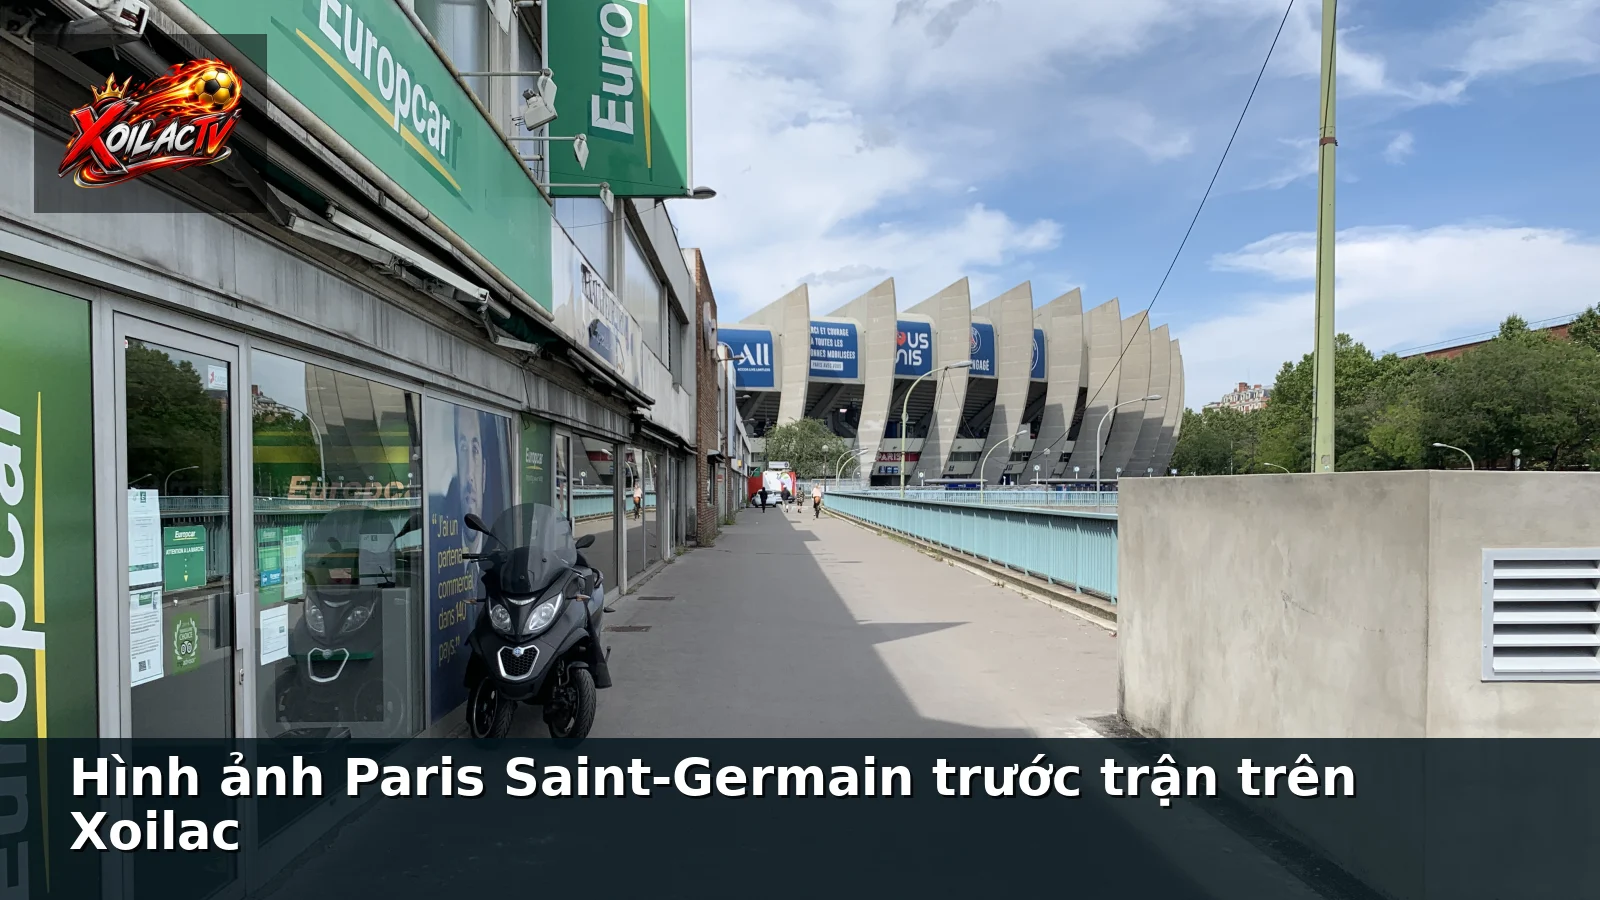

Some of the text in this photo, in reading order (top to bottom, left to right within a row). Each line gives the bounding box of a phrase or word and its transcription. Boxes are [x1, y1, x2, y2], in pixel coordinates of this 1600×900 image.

[591, 0, 648, 135] Euro
[319, 0, 450, 157] Europcar
[820, 327, 826, 335] ET
[834, 339, 844, 348] LES
[174, 530, 197, 539] Europcar
[450, 519, 459, 536] un
[438, 607, 455, 631] dans
